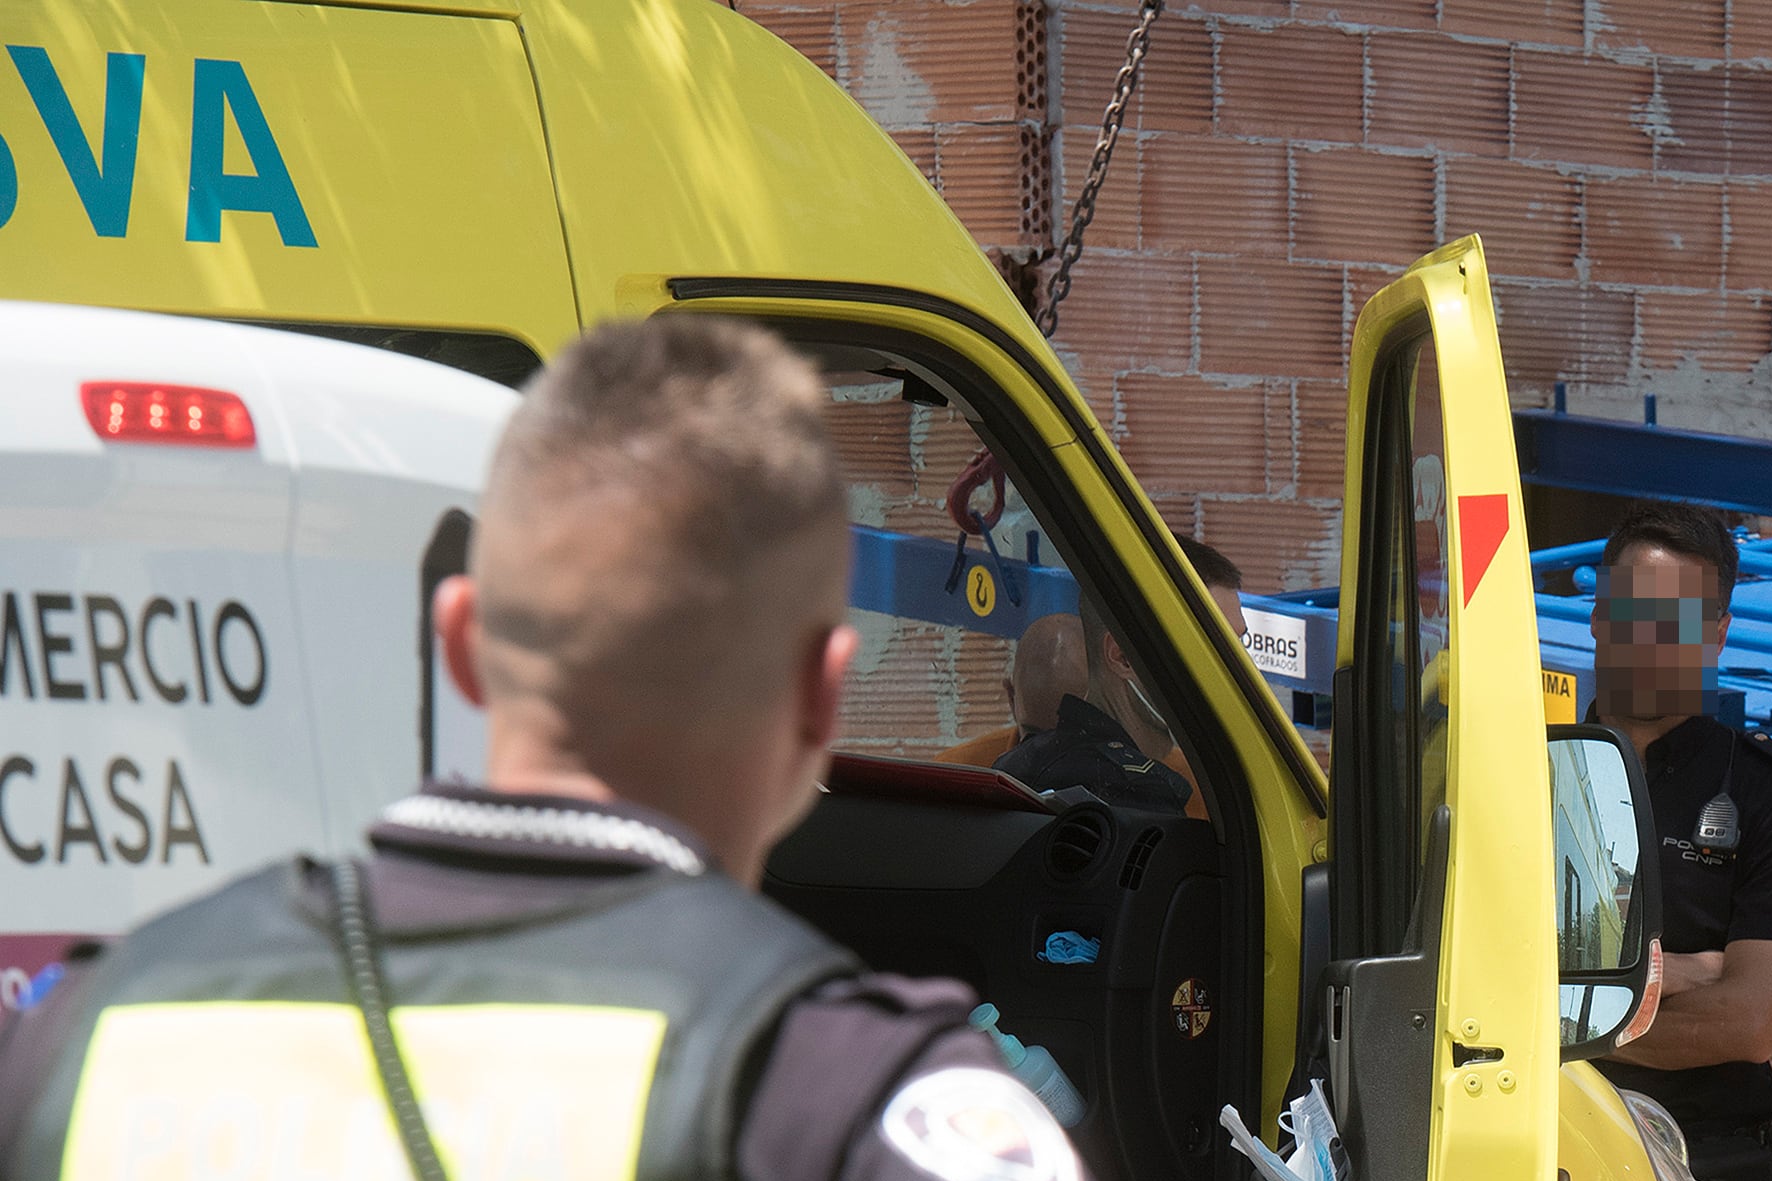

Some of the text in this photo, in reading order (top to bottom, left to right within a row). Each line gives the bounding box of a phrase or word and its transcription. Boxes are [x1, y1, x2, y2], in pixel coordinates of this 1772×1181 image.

[0, 44, 319, 248] VA
[1251, 653, 1298, 672] COFRADOS
[0, 753, 210, 865] CASA
[1682, 851, 1723, 866] CNP
